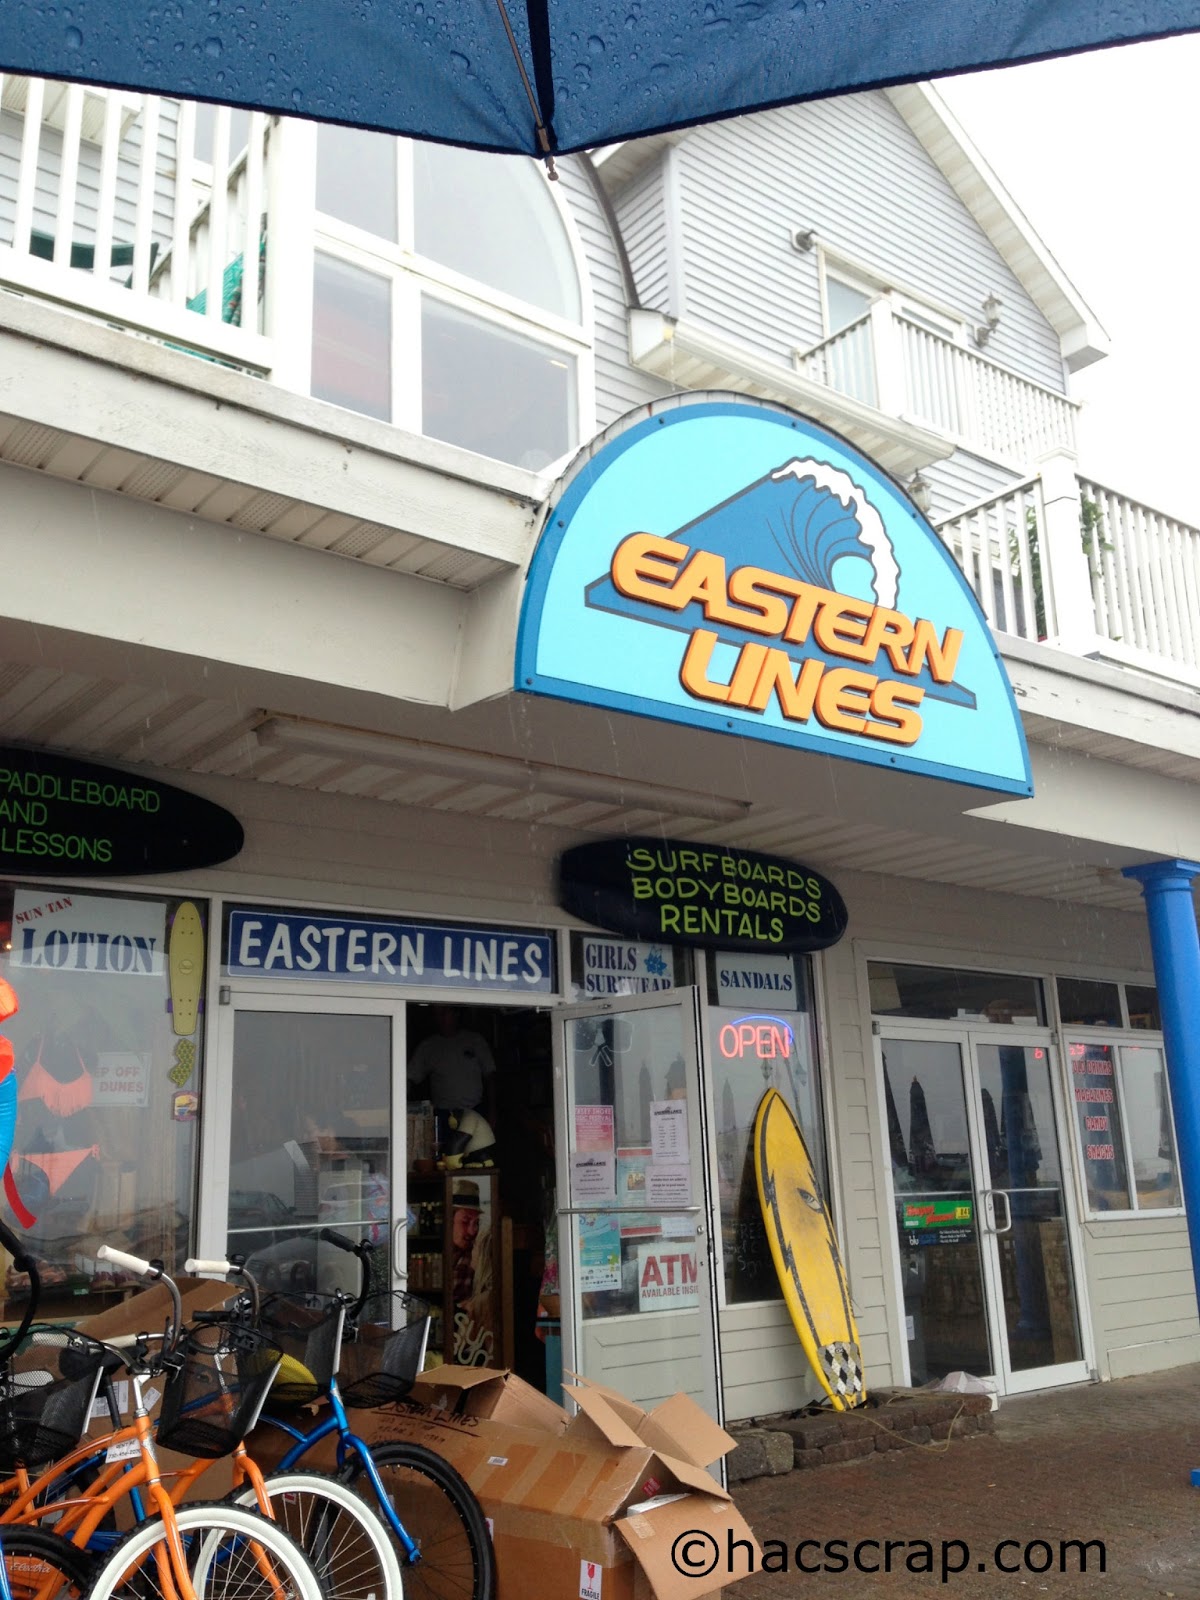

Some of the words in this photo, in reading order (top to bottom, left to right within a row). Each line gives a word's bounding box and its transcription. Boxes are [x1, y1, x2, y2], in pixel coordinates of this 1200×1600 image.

[611, 531, 964, 684] EASTERN
[679, 629, 925, 746] LINES
[0, 768, 160, 813] PADDLEBOARD
[0, 799, 48, 826] AND
[1, 828, 113, 862] LESSONS
[626, 848, 821, 900] SURFBOARDS
[15, 907, 44, 925] SUN
[45, 896, 73, 915] TAN
[632, 877, 821, 923] BODYBOARDS
[660, 904, 784, 943] RENTALS
[19, 927, 157, 973] LOTION
[238, 920, 424, 977] EASTERN
[443, 936, 543, 984] LINES
[585, 943, 637, 971] GIRLS
[720, 969, 792, 991] SANDALS
[719, 1024, 790, 1059] OPEN
[1075, 1088, 1114, 1103] MAGAZINES
[1085, 1115, 1109, 1131] CANDY
[1087, 1144, 1114, 1160] SNACKS
[642, 1286, 680, 1298] AVAILABLE
[681, 1285, 699, 1295] INSI
